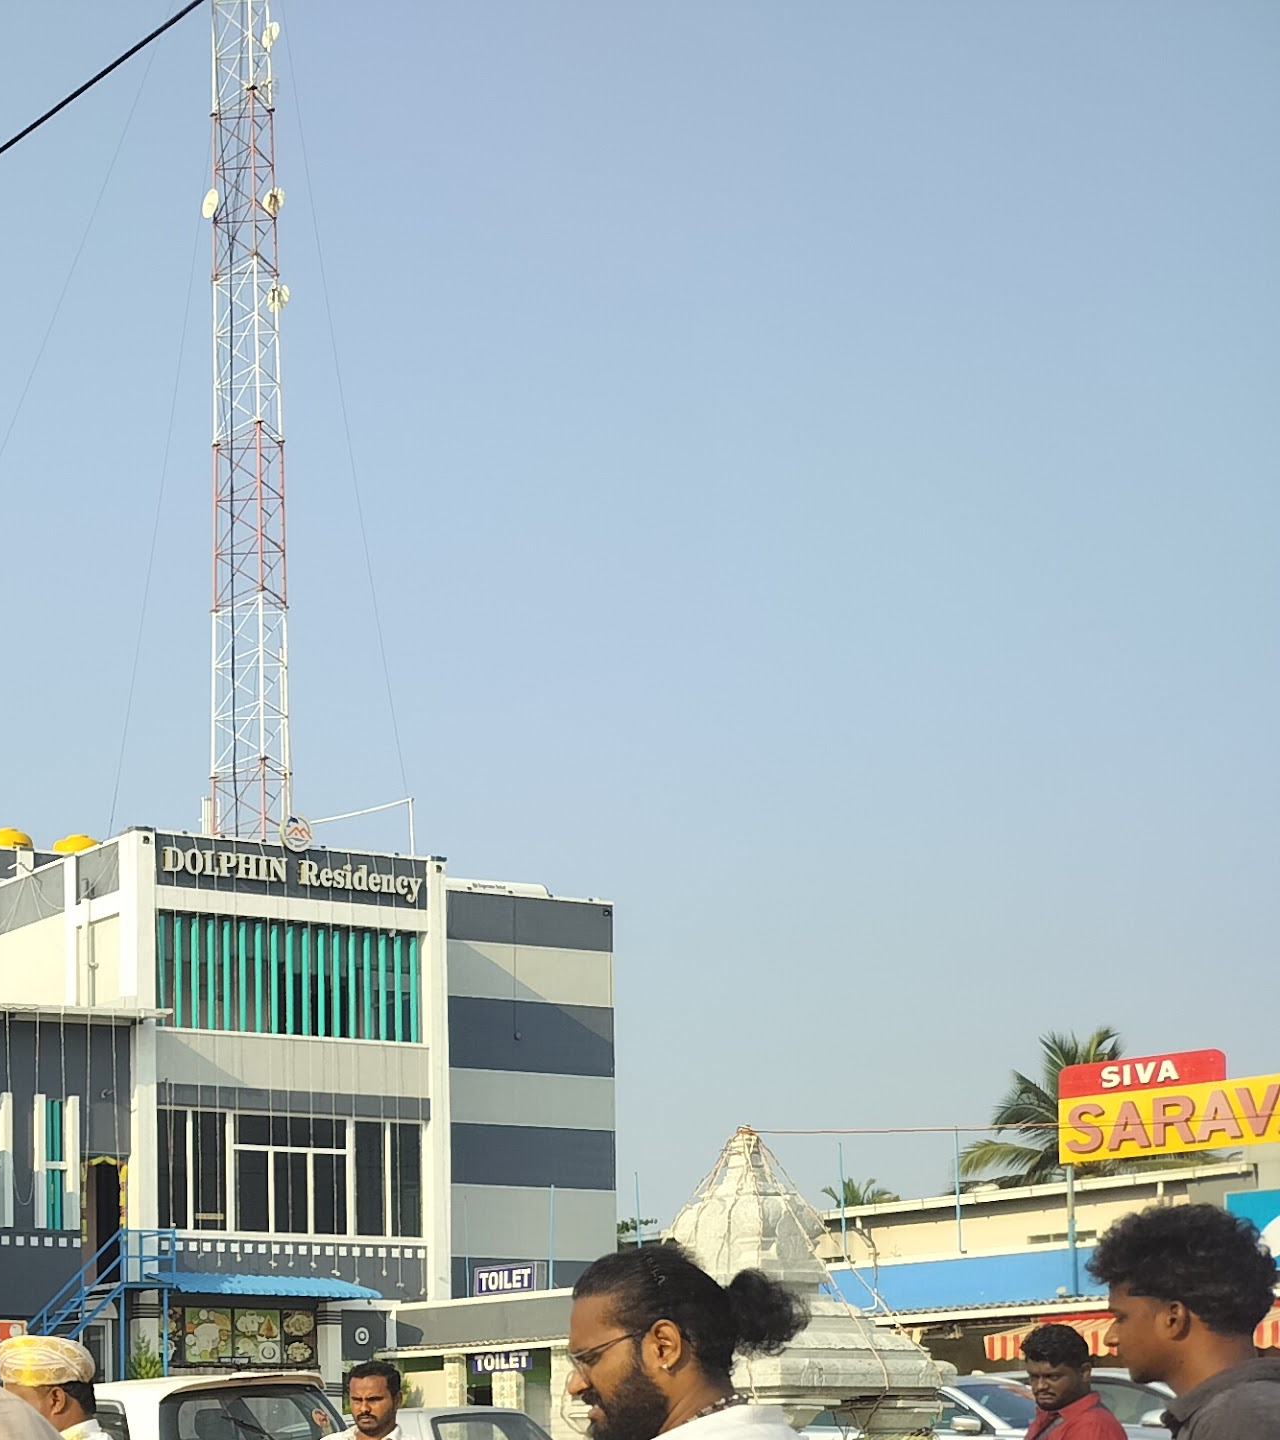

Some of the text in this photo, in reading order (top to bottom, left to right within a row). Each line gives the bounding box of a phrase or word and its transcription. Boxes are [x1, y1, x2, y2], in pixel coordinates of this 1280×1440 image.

[162, 846, 423, 902] DOLPHIN Residency
[1100, 1059, 1180, 1089] SIVA
[1065, 1084, 1280, 1155] SARAV
[479, 1268, 531, 1292] TOILET
[474, 1351, 529, 1372] TOILET
